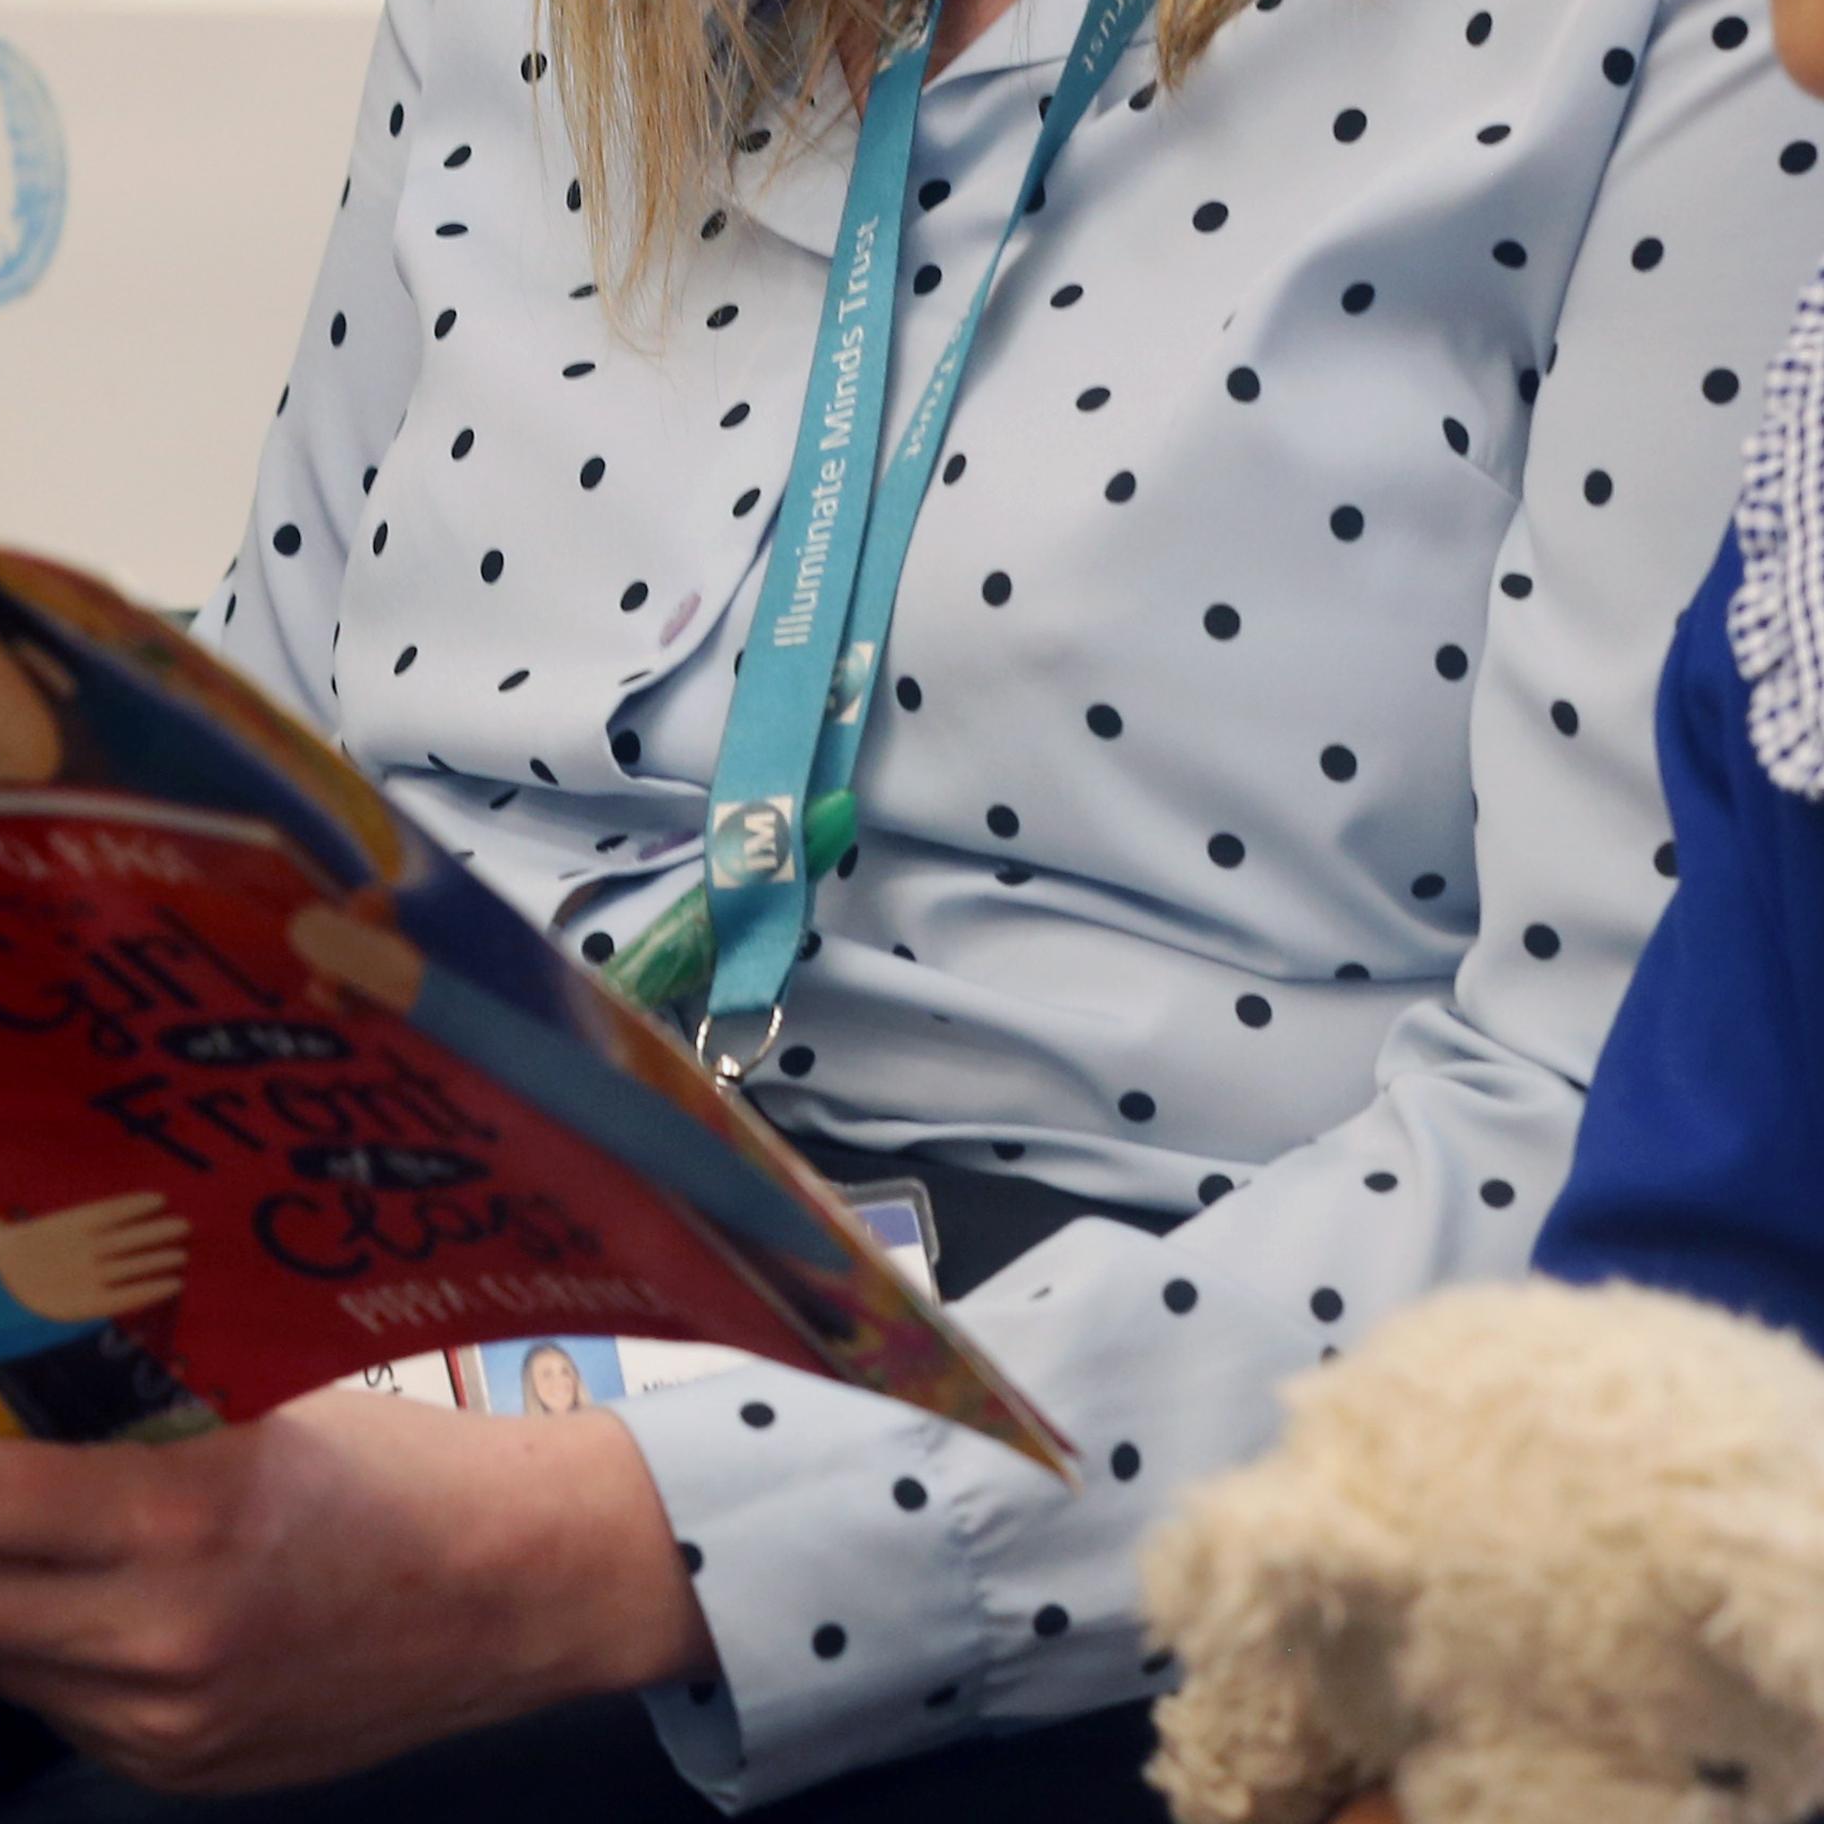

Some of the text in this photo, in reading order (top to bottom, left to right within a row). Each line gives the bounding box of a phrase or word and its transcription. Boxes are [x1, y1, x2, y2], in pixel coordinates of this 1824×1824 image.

[774, 214, 880, 647] Illuminate Minds Trust
[88, 1049, 498, 1172] Front
